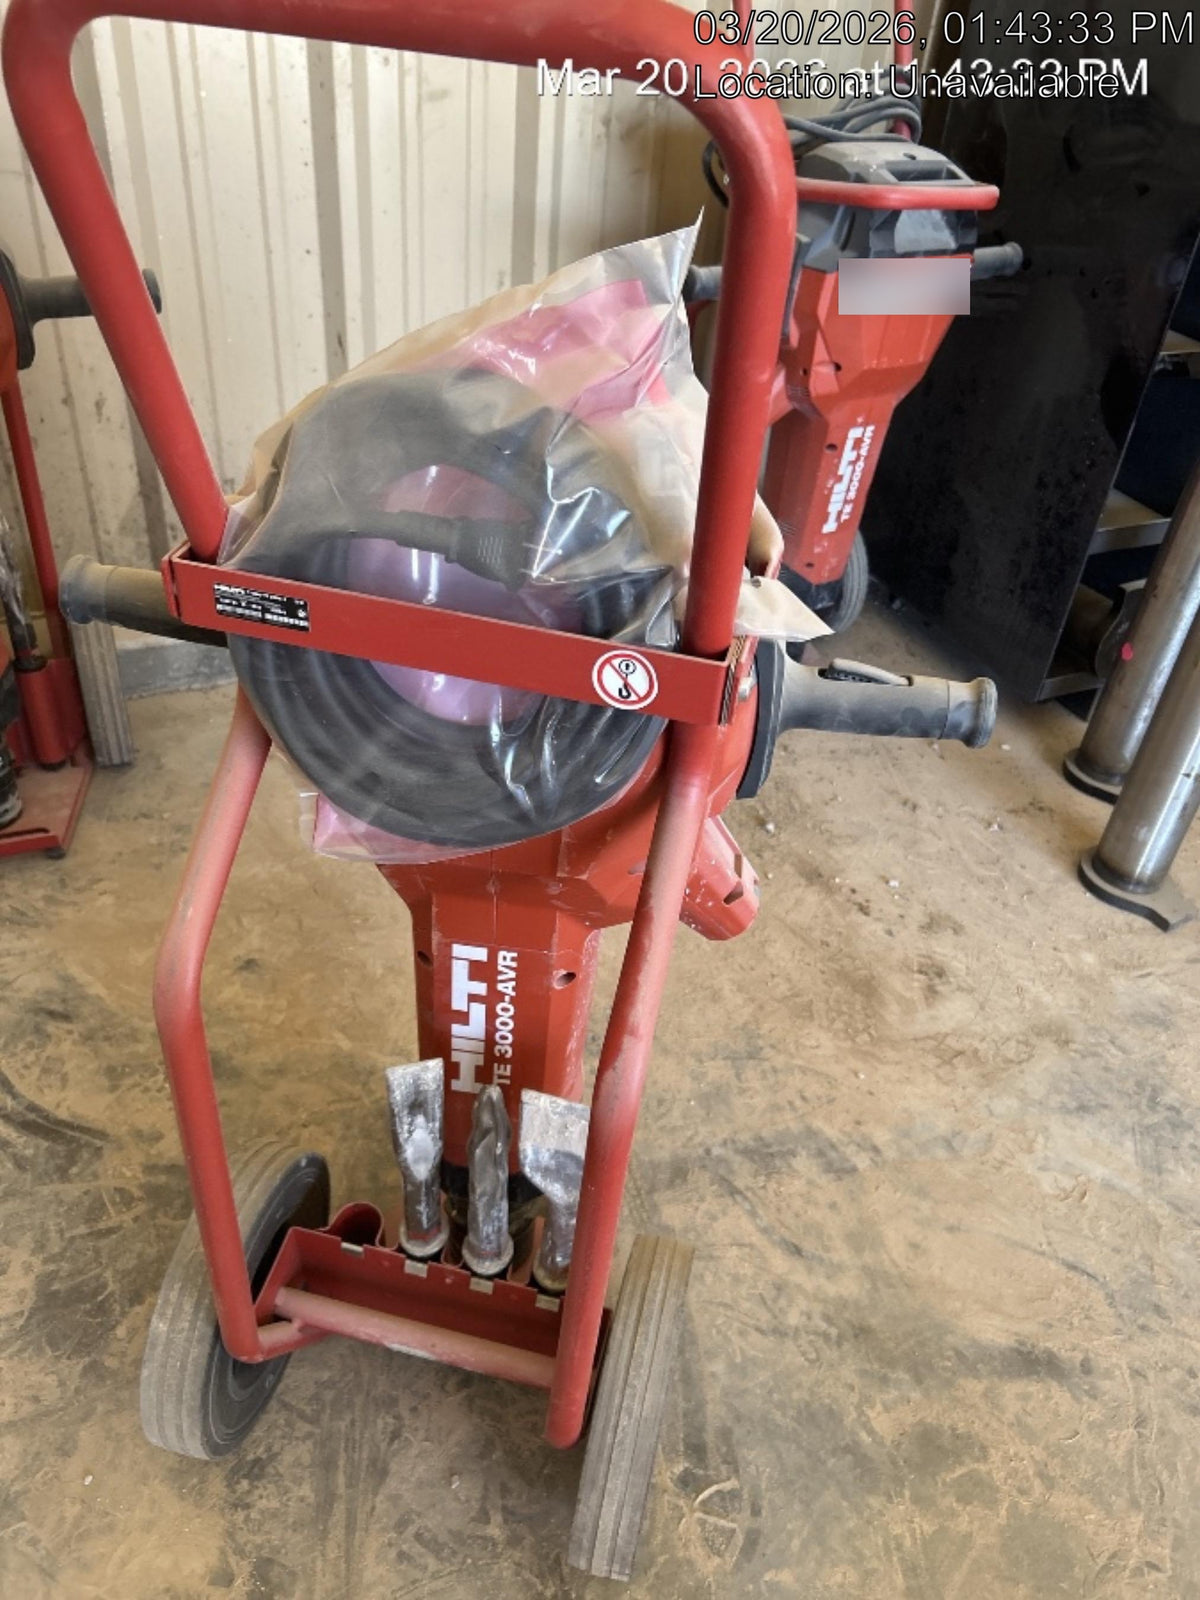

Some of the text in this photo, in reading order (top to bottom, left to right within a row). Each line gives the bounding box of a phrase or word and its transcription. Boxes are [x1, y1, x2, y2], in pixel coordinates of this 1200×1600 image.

[821, 426, 865, 534] HILTI
[840, 424, 876, 524] TE 3000-AVR
[451, 943, 488, 1094] HILTI
[493, 950, 519, 1086] TE 3000-AVR
